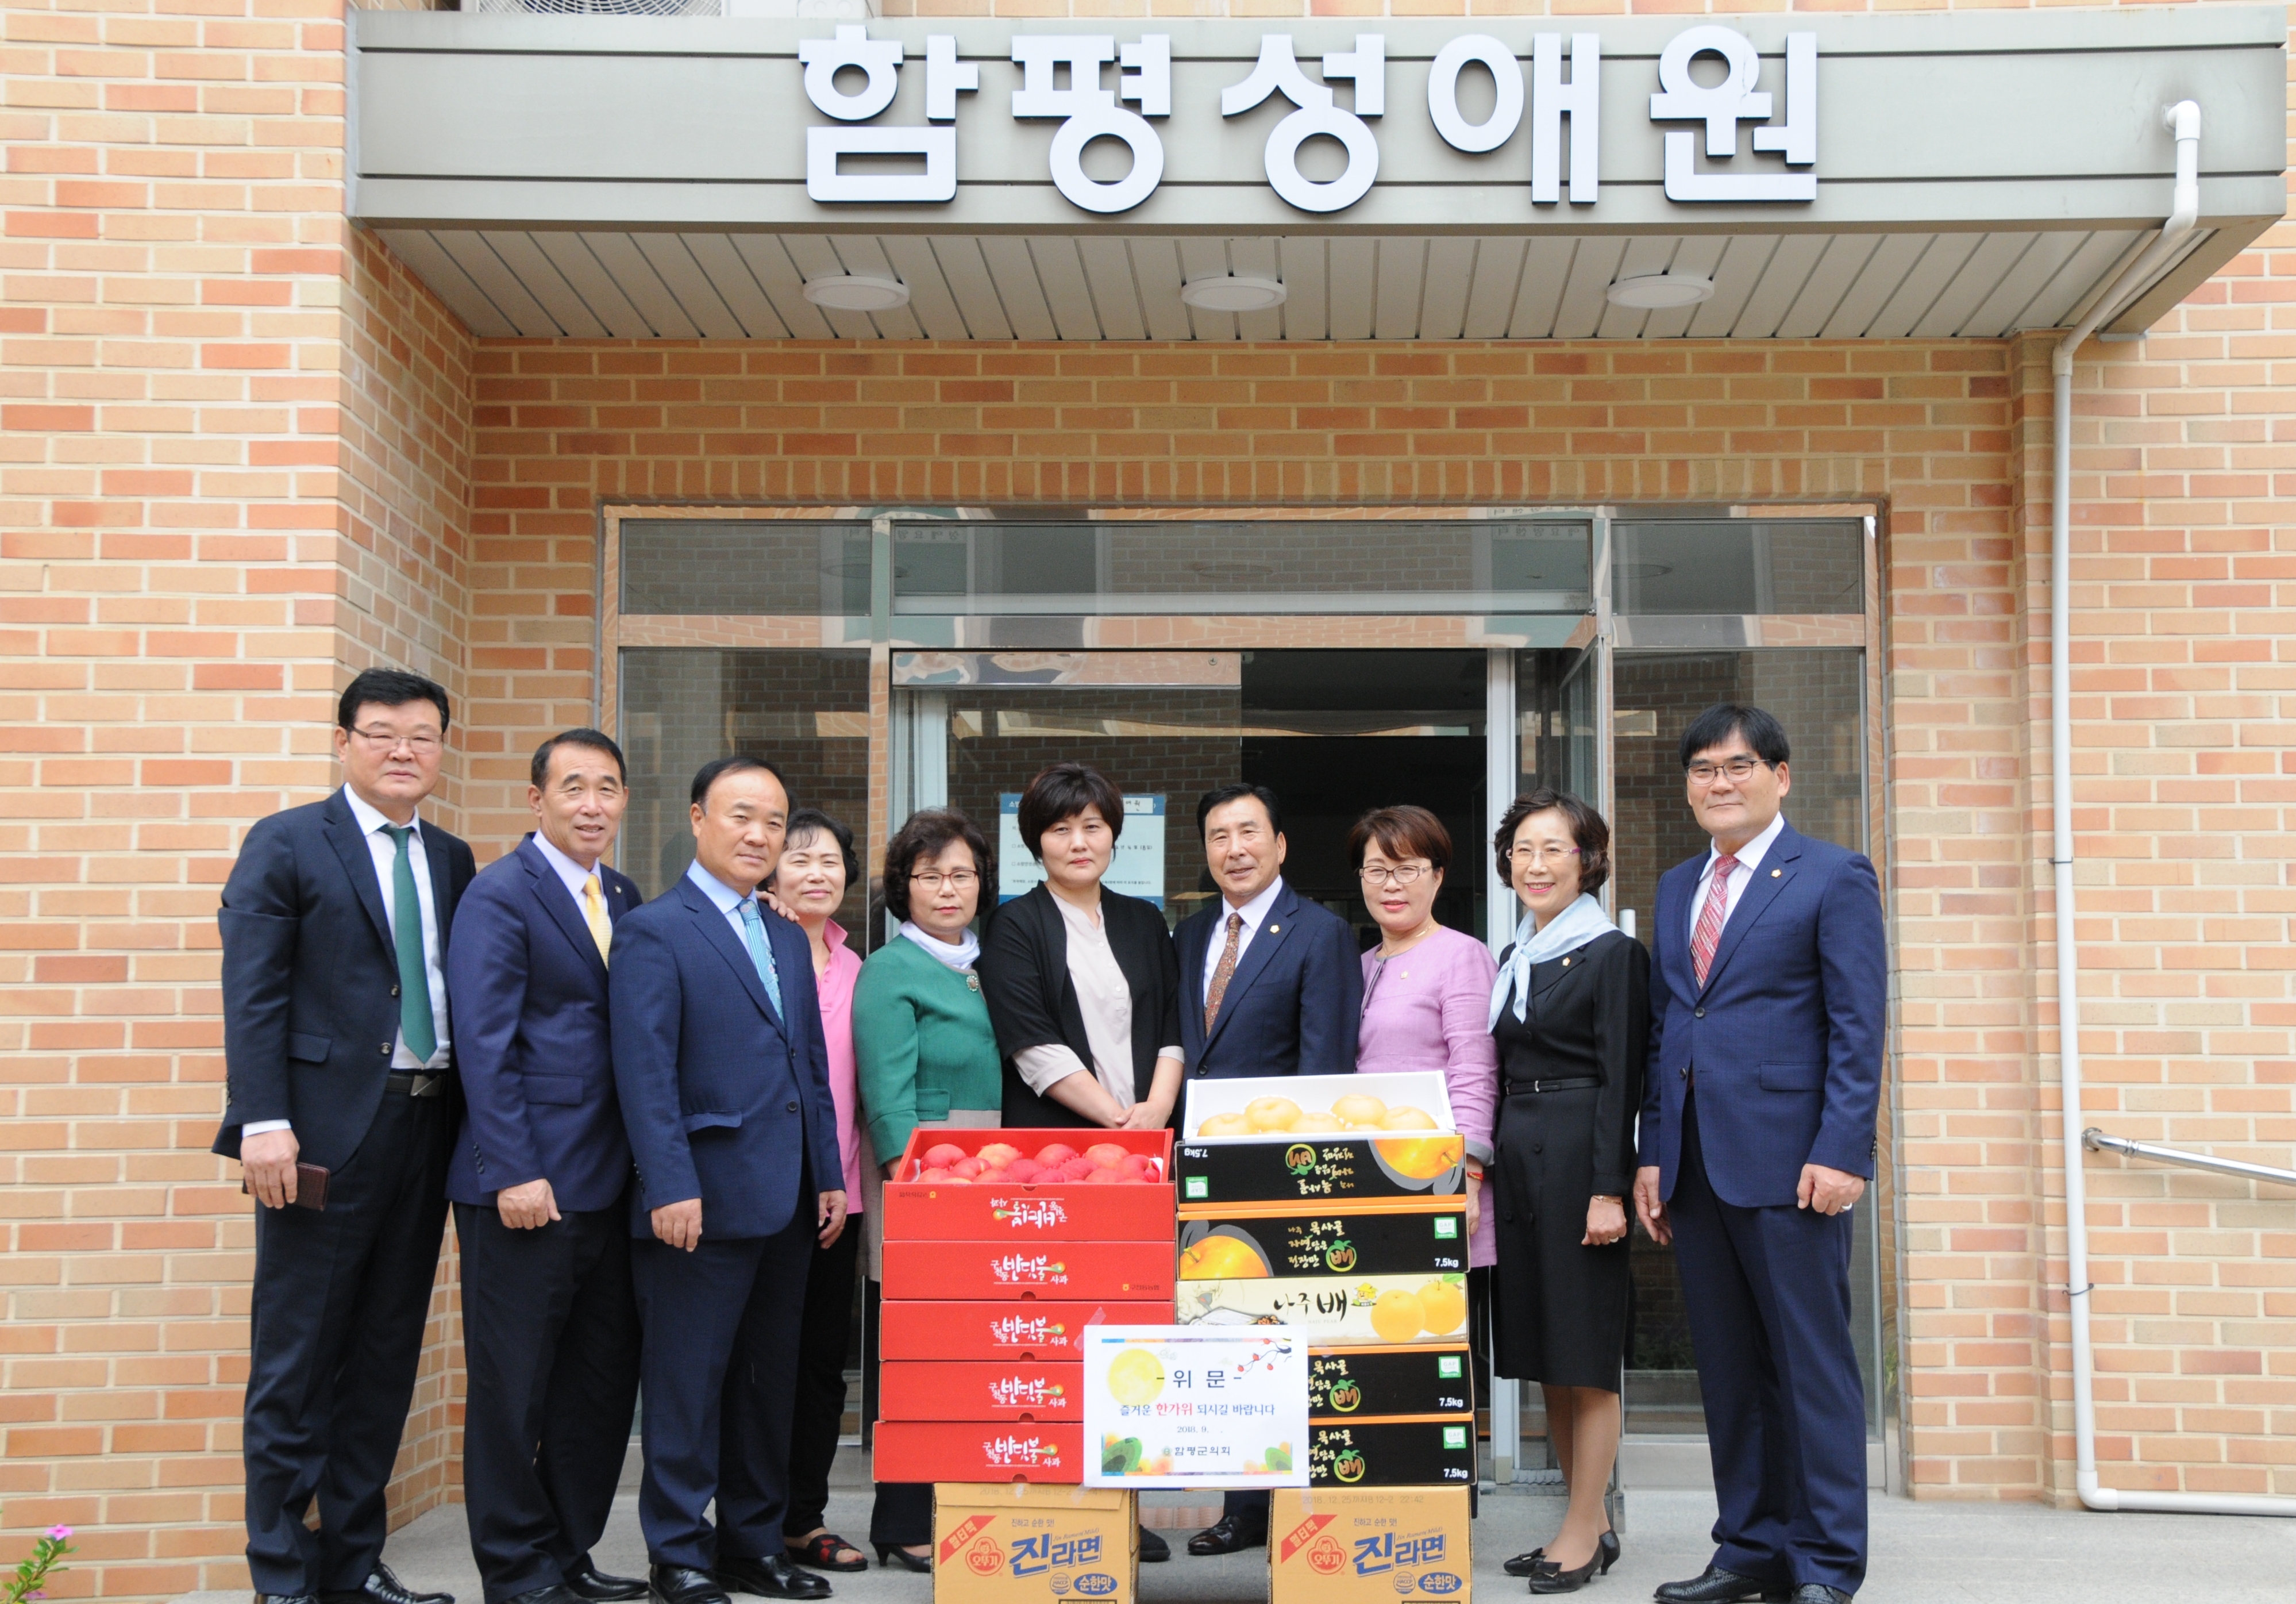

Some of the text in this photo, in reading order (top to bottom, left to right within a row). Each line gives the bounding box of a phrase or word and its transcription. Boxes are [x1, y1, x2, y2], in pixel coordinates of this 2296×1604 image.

[798, 25, 1818, 214] 함평성애원
[1184, 1148, 1208, 1158] 7.5kg
[990, 1198, 1008, 1207] 사과
[1434, 1257, 1459, 1268] 7.5kg
[1050, 1275, 1068, 1284] 사과
[1273, 1289, 1347, 1322] 나주 배
[1050, 1336, 1068, 1346] 사과
[1049, 1398, 1067, 1408] 사과
[1439, 1397, 1463, 1407] 7.5kg
[1120, 1403, 1275, 1415] 즐거운 한가위 되시길 바랍니다
[1174, 1446, 1231, 1456] 함평군의회
[1042, 1457, 1061, 1467] 사과
[1443, 1468, 1468, 1479] 7.5kg
[1011, 1518, 1029, 1527] 진하고
[1032, 1518, 1043, 1527] 순한
[1354, 1518, 1372, 1526] 진하고
[1374, 1518, 1386, 1526] 순한
[1009, 1533, 1103, 1579] 진라면
[1313, 1554, 1340, 1565] 오뚜기
[1353, 1532, 1446, 1577] 진라면
[972, 1555, 999, 1567] 오뚜기
[1078, 1576, 1112, 1592] 순한맛
[1423, 1575, 1457, 1591] 순한맛
